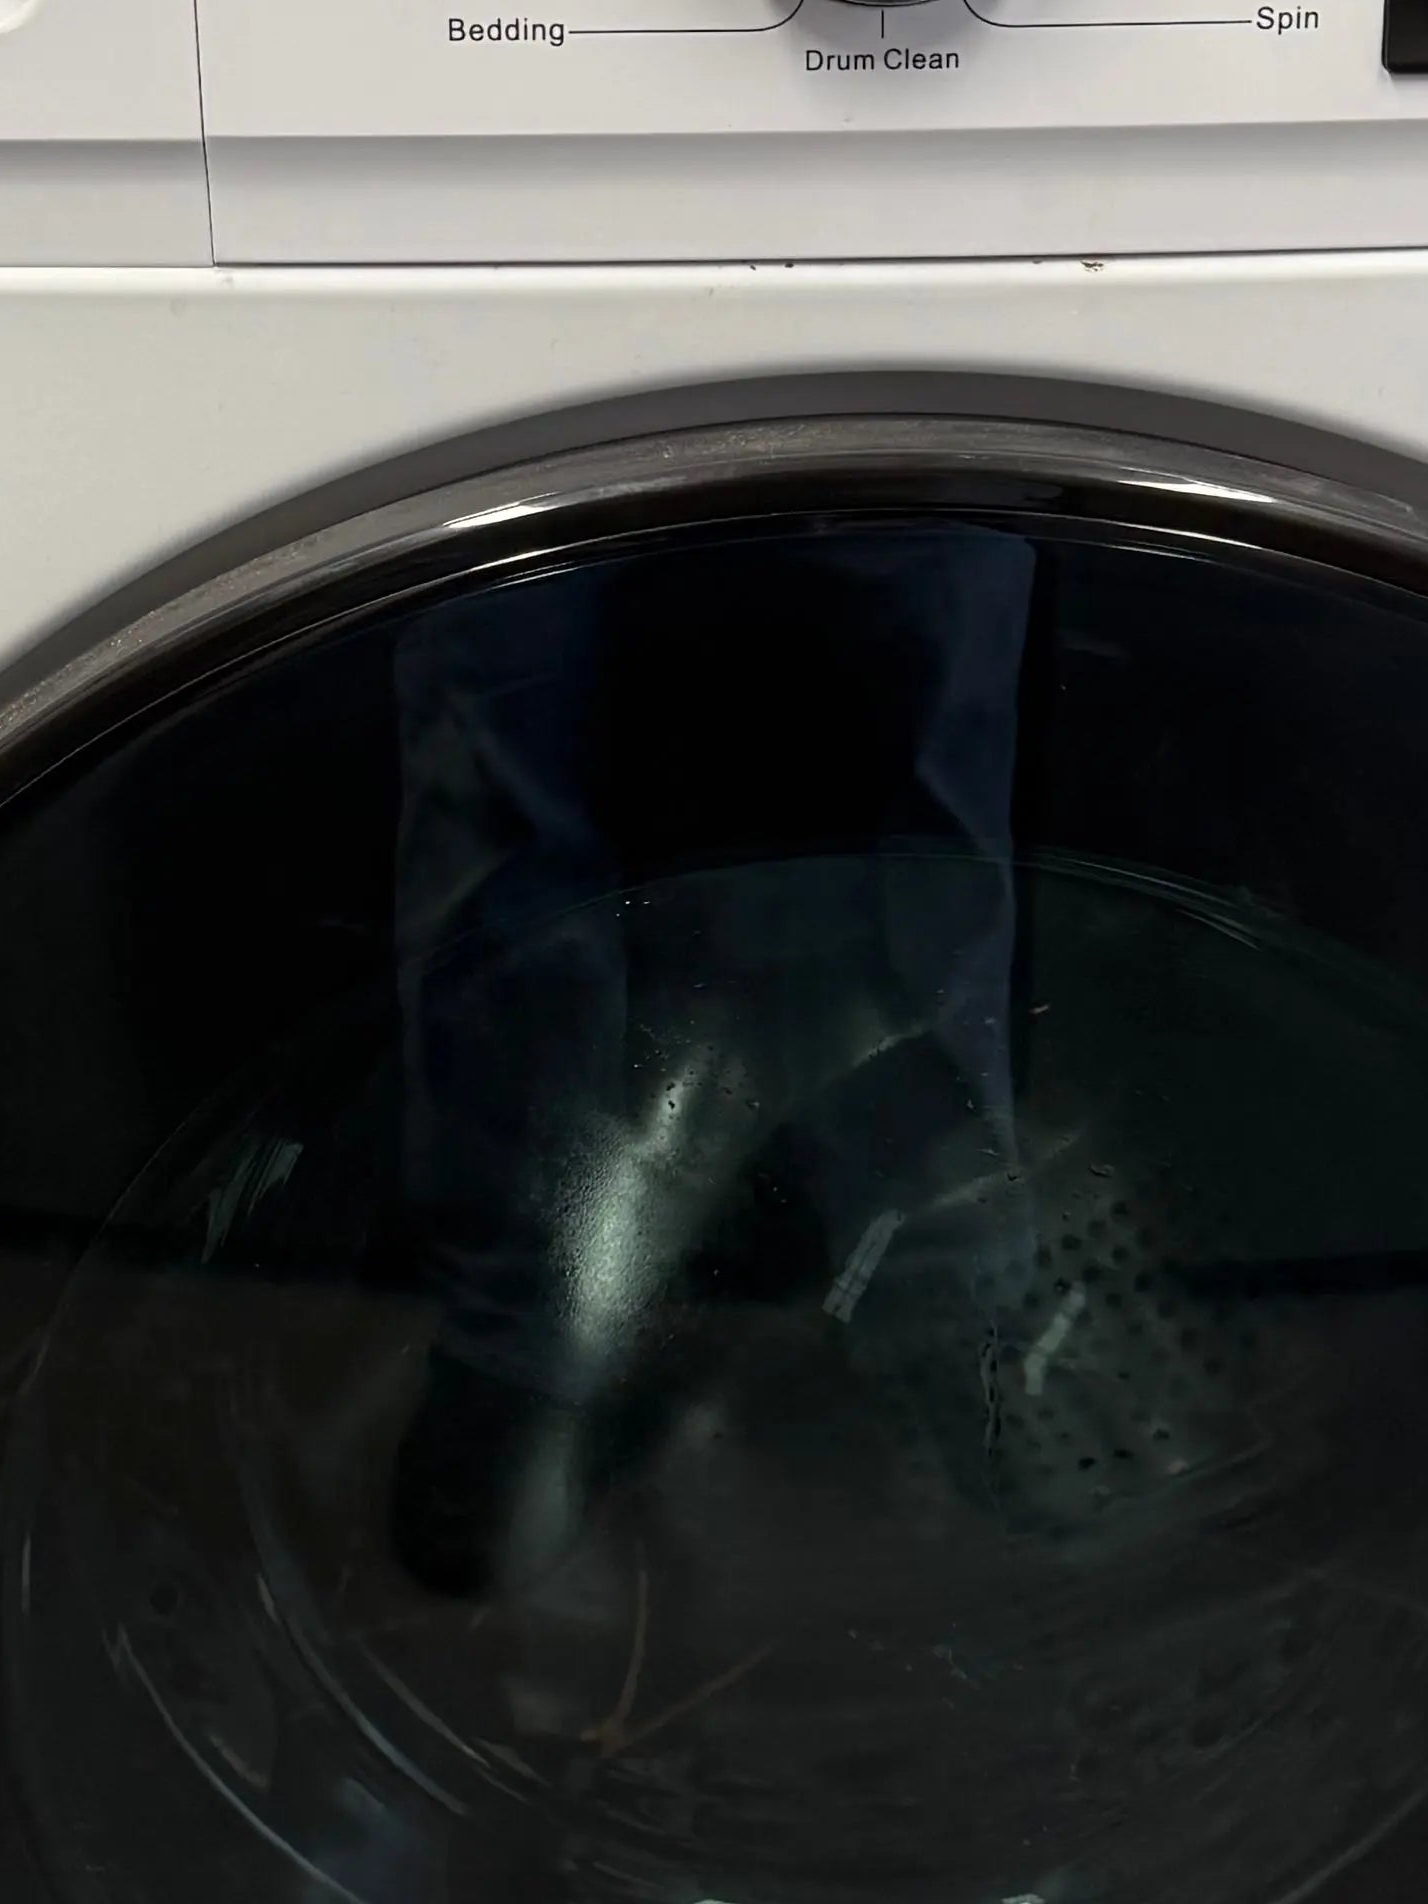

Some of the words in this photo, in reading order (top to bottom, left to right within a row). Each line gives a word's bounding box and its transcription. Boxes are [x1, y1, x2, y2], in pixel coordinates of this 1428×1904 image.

[447, 16, 565, 48] Bedding
[1255, 5, 1320, 37] Spin
[805, 48, 876, 72] Drum
[882, 46, 960, 71] Clean
